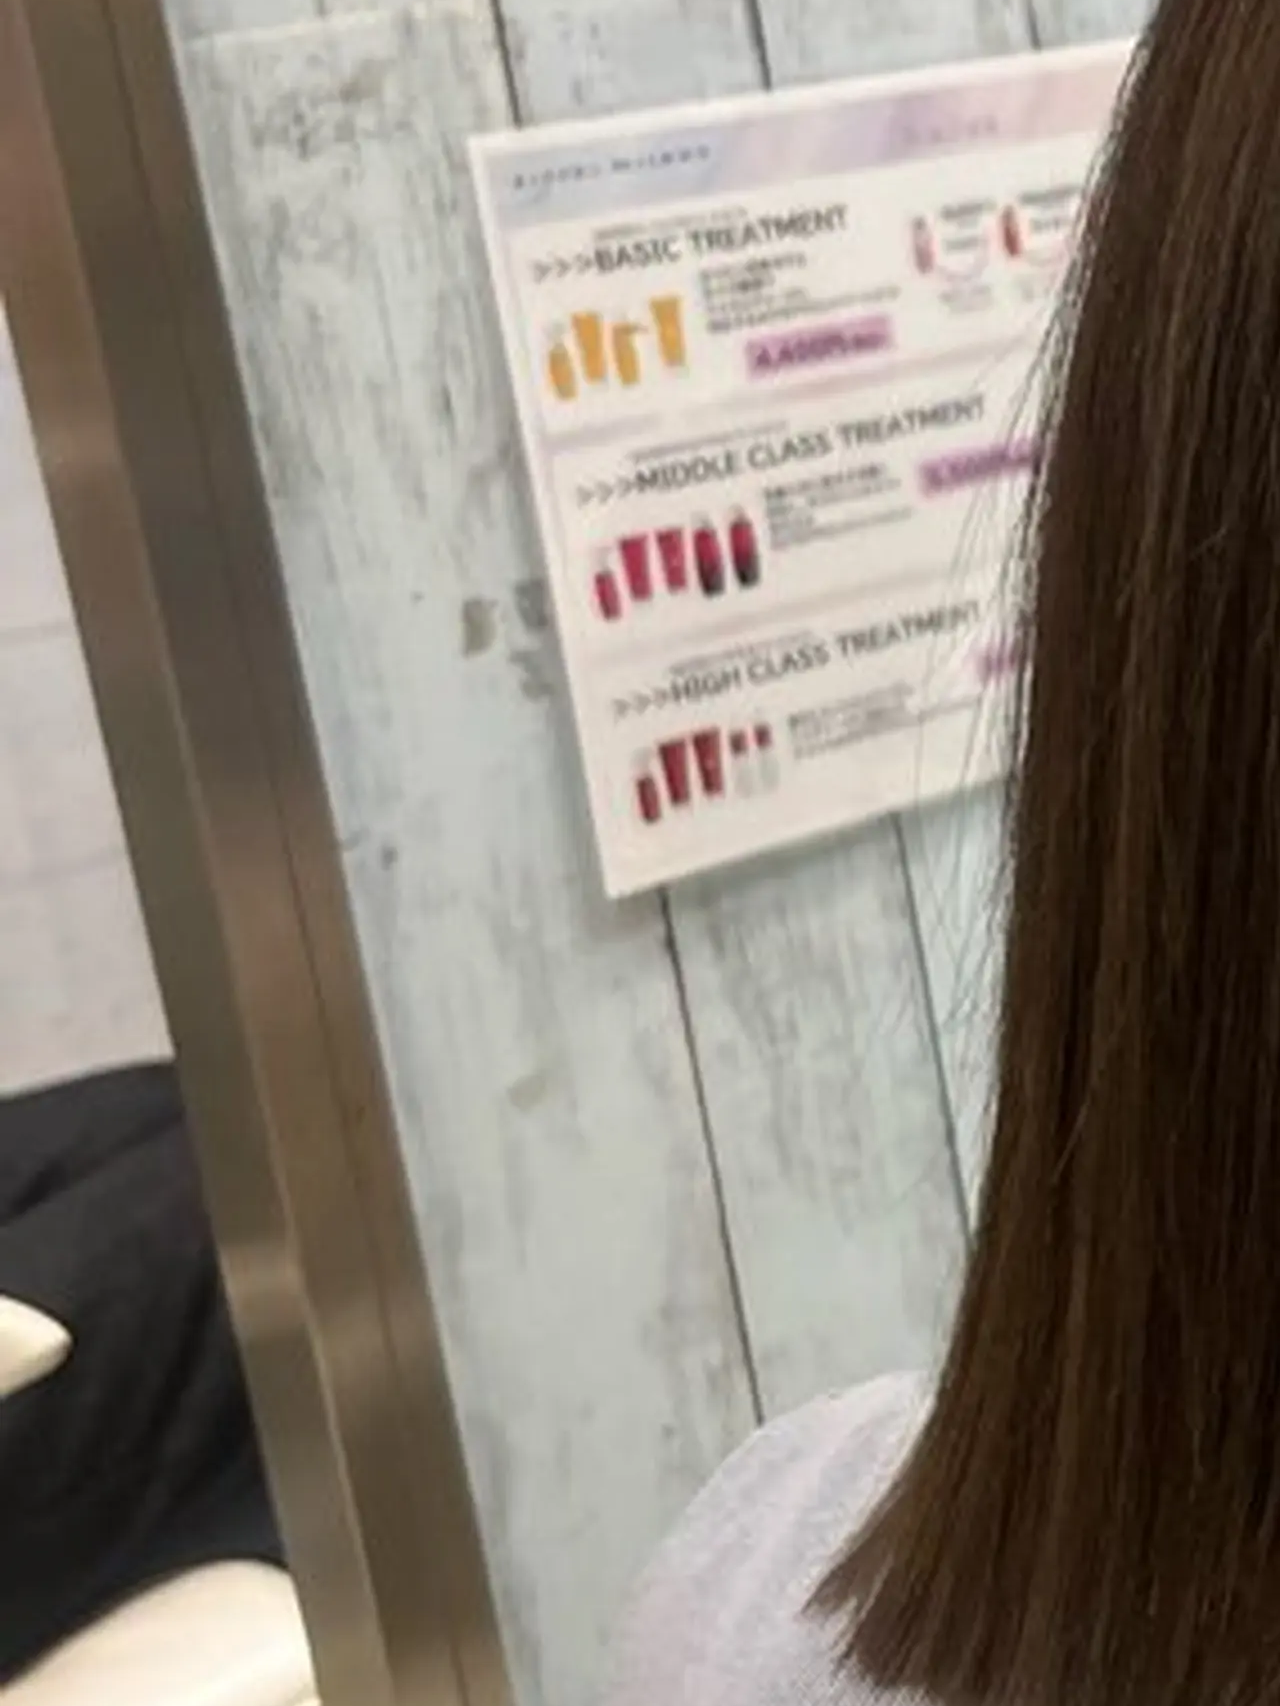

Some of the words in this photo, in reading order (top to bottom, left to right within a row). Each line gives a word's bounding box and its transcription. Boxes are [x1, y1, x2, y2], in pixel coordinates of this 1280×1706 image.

[594, 235, 681, 274] BASIC
[688, 204, 847, 251] TREATMENT
[634, 448, 736, 495] MIDDLE
[747, 429, 832, 469] CLASS
[837, 395, 985, 447] TREATMENT
[669, 666, 741, 704] HIGH
[748, 642, 830, 684] CLASS
[837, 600, 980, 659] TREATMENT
